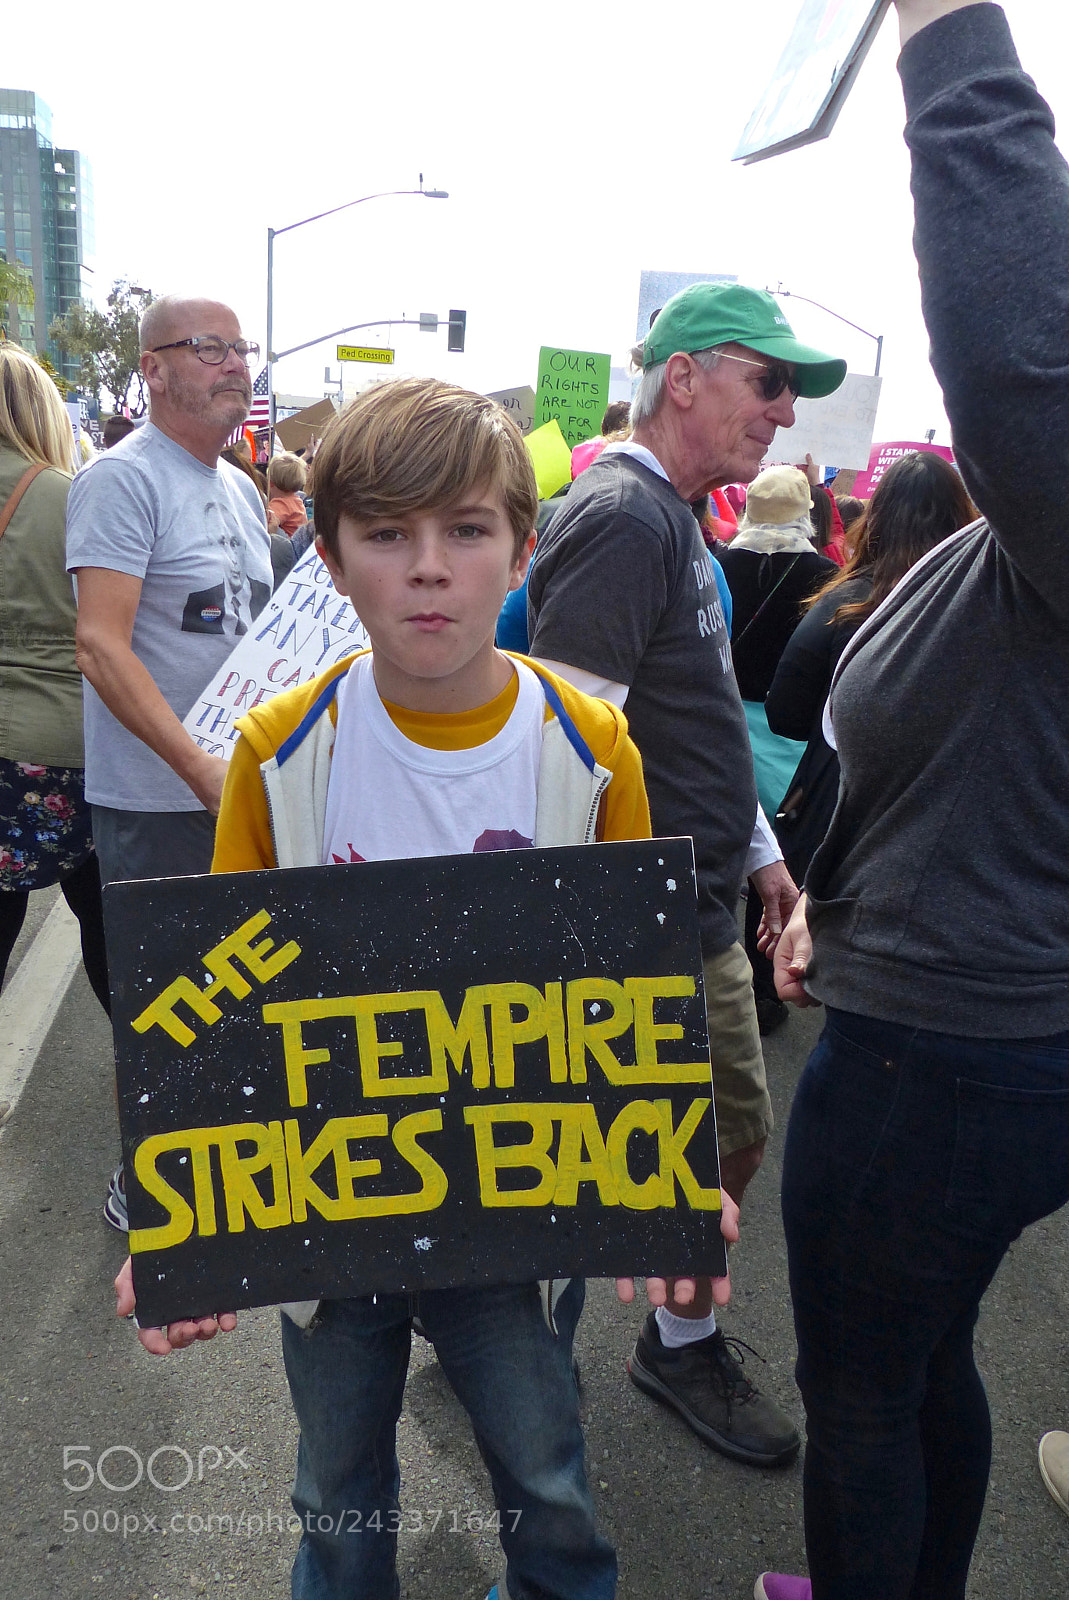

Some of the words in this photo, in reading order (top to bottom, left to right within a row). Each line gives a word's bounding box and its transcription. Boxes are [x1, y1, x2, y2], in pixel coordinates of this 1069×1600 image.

[341, 348, 356, 357] Ped
[358, 350, 391, 363] Crossing
[550, 351, 597, 375] OUR
[541, 374, 599, 395] RIGHTS
[542, 395, 571, 408] ARE
[576, 399, 600, 410] NOT
[568, 415, 593, 431] FOR
[878, 457, 898, 465] WIT
[880, 448, 886, 456] I
[870, 474, 883, 483] PA
[873, 465, 885, 474] PL
[697, 599, 726, 638] RUS
[267, 658, 316, 687] CA
[217, 671, 278, 711] PRE
[130, 908, 302, 1048] THE
[262, 975, 712, 1108] FEMPIRE
[463, 1097, 722, 1211] BACK
[129, 1108, 449, 1254] STRIKES
